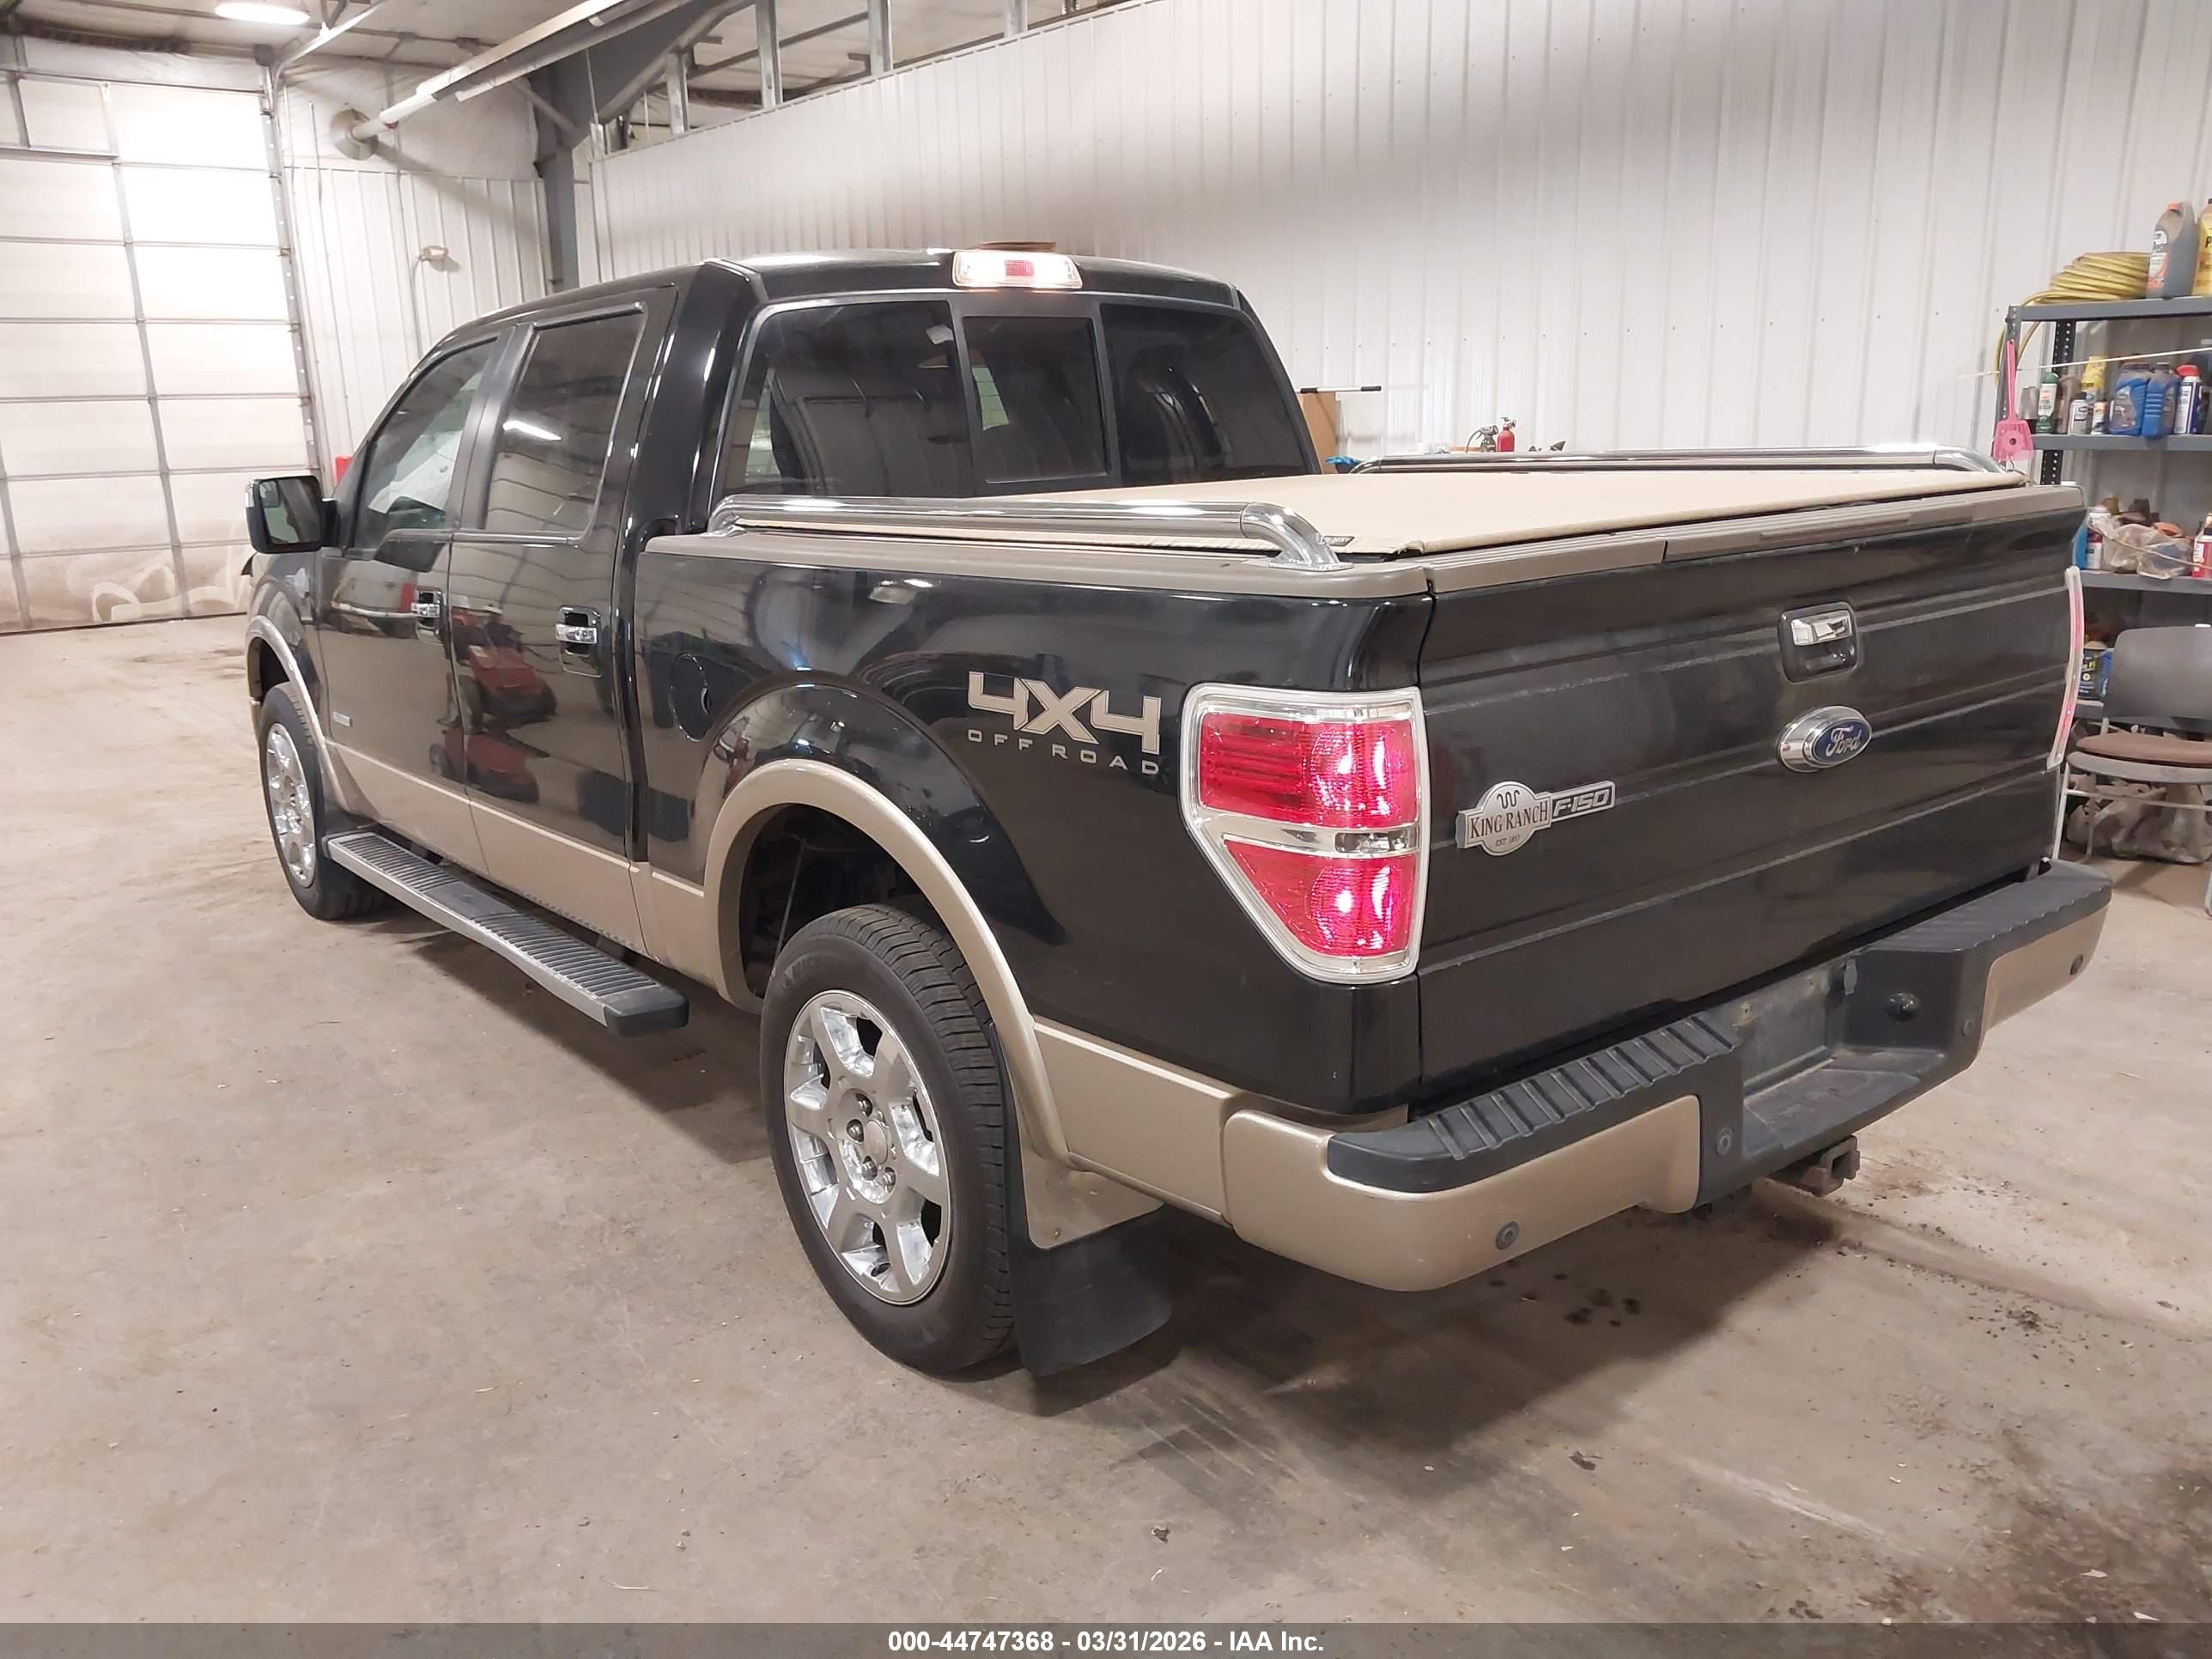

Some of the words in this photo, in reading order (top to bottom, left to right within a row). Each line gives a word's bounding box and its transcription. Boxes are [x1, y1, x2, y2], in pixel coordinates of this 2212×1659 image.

[968, 729, 1033, 750] OFF
[1052, 744, 1159, 775] ROAD
[1826, 725, 1863, 757] Ford
[1470, 816, 1503, 838] KING
[1505, 799, 1548, 830] RANCH
